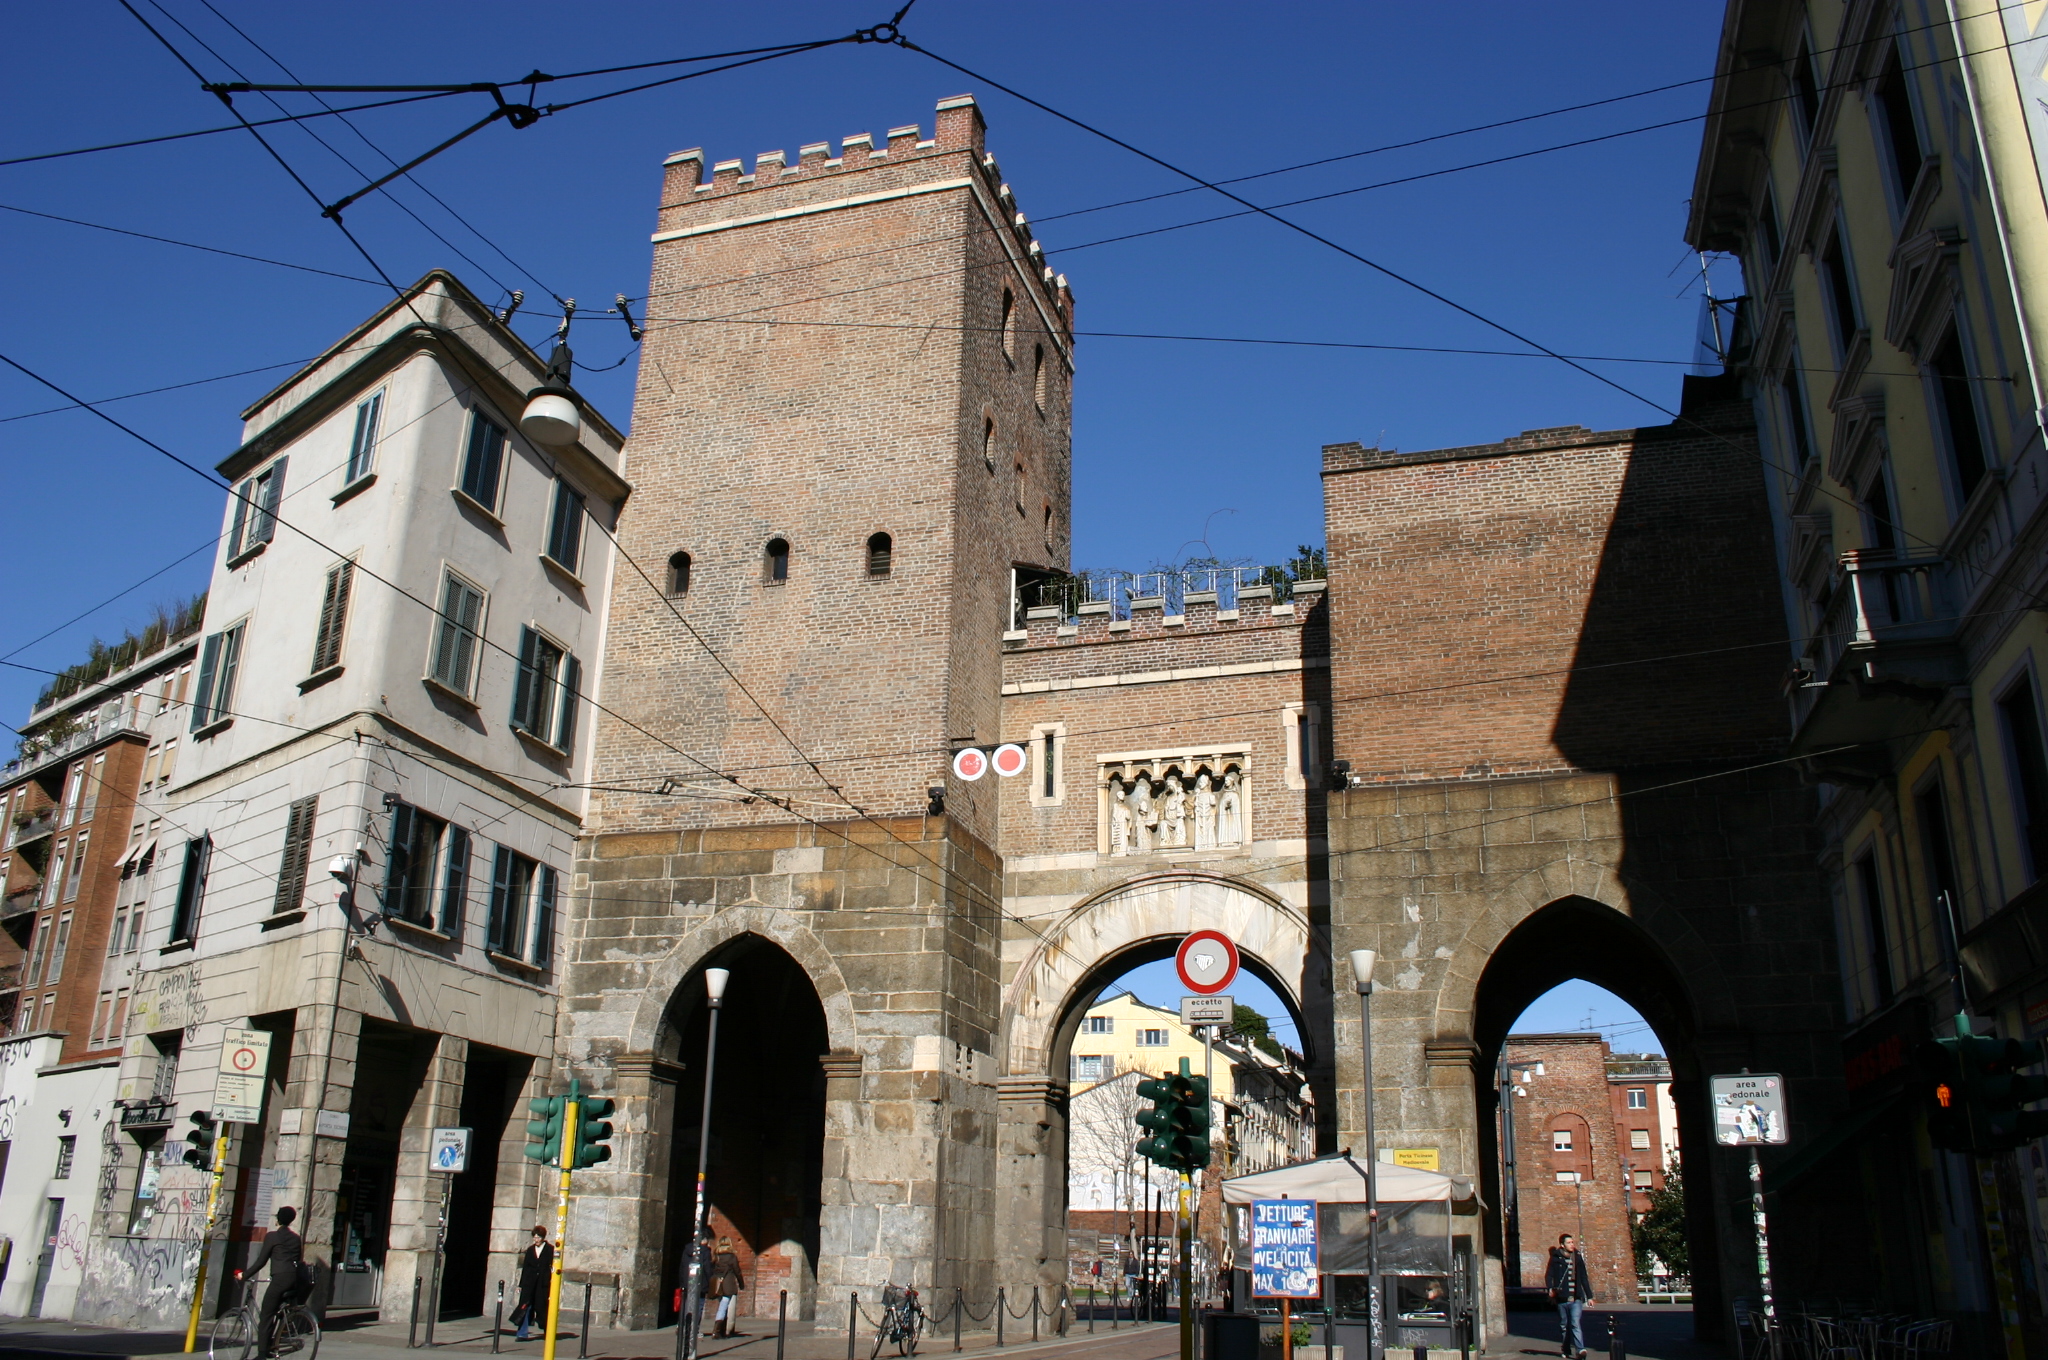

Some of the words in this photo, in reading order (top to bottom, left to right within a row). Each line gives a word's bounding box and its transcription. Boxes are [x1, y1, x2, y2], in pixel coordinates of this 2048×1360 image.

[1731, 1090, 1770, 1099] edonale
[1257, 1205, 1307, 1222] VETTURE
[1254, 1227, 1316, 1245] TRANVIARIE
[1253, 1273, 1274, 1290] MAX
